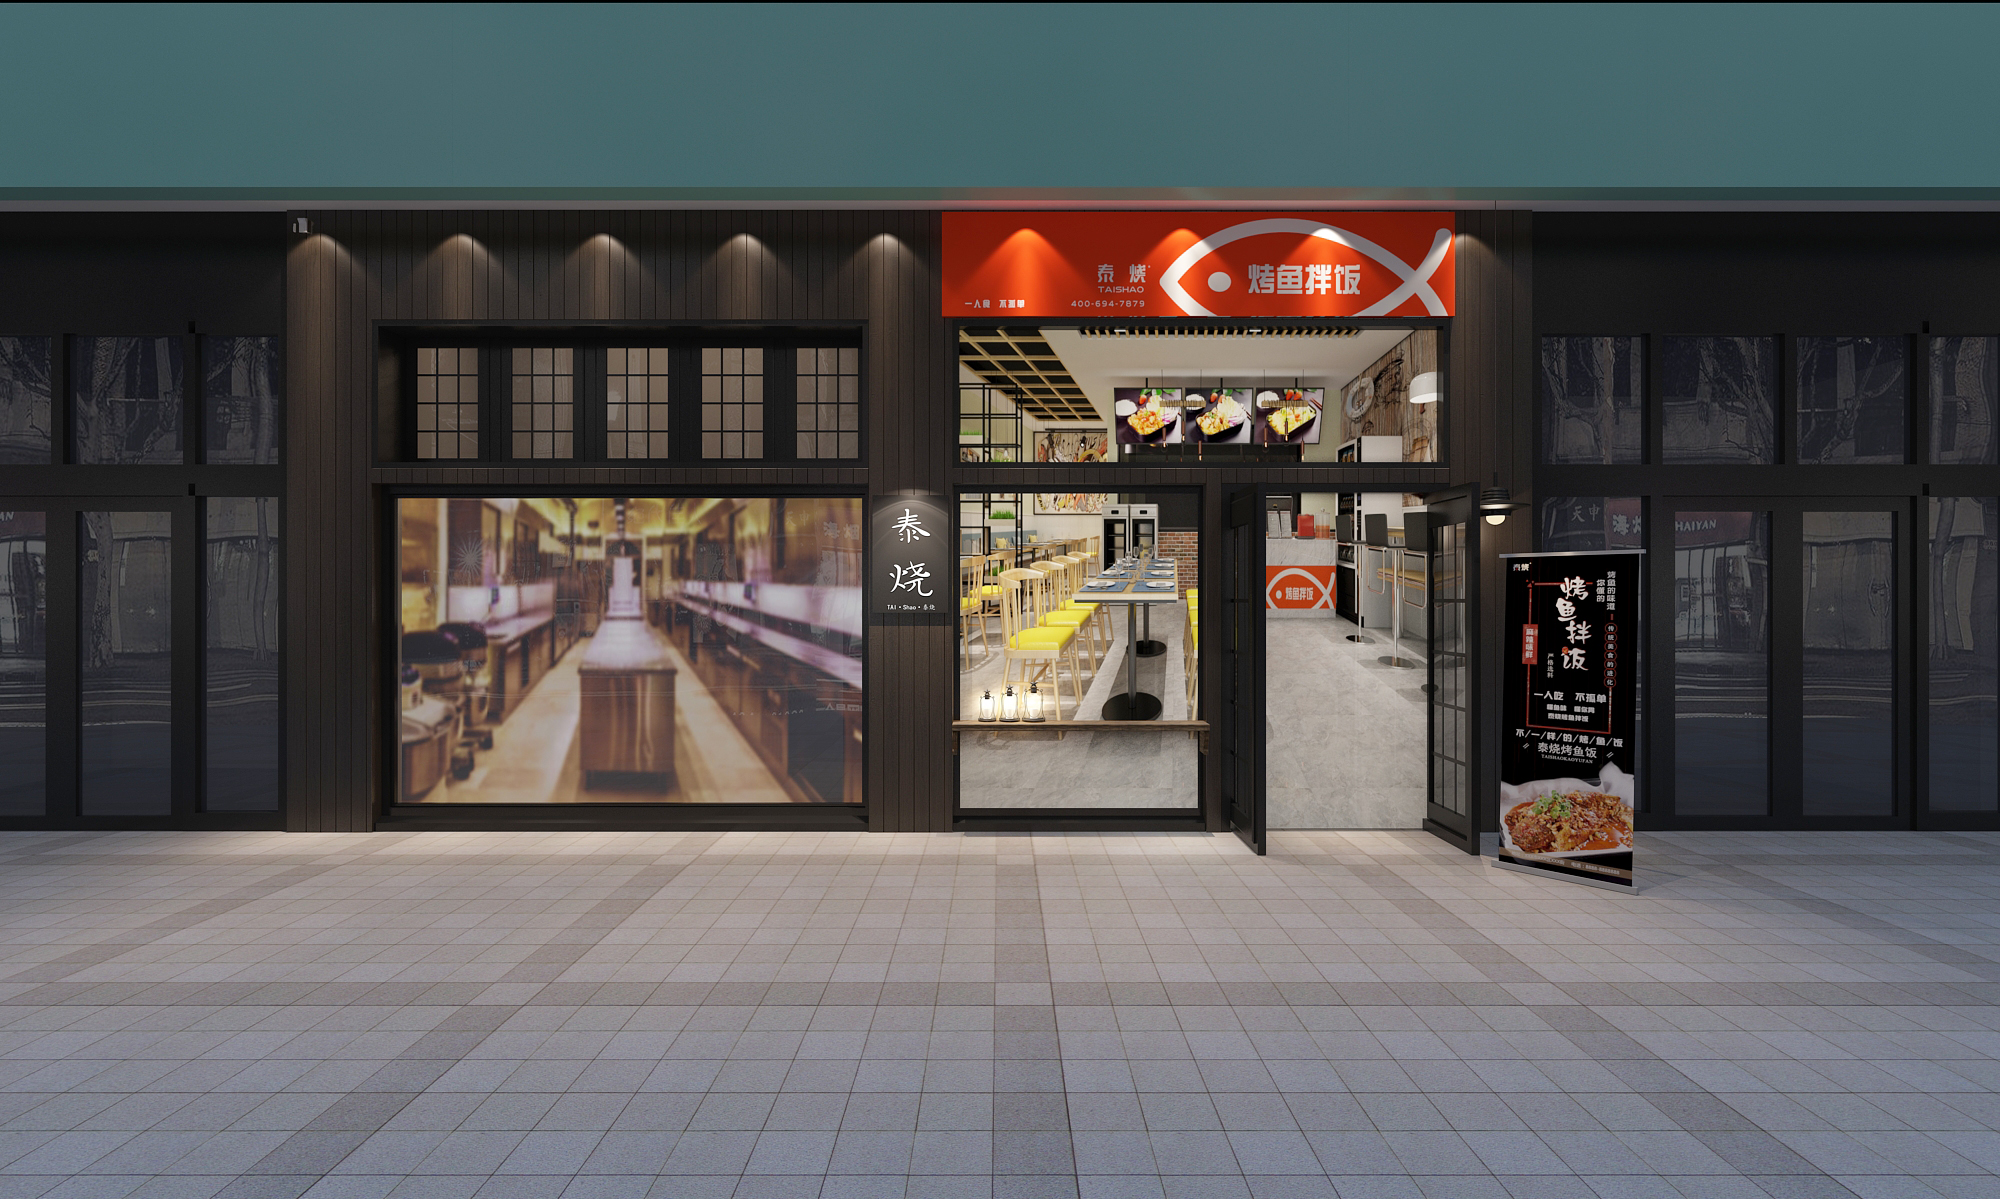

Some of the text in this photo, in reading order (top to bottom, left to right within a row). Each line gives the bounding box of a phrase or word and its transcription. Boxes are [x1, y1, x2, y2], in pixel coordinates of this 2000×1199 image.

[1248, 264, 1360, 295] 烤鱼拌饭
[1098, 286, 1144, 294] TAISHAO
[1675, 518, 1716, 532] HAIYAN
[889, 508, 934, 596] 泰烧
[1285, 587, 1314, 600] 烤鱼拌饭
[1596, 579, 1606, 602] 你懂的
[1607, 571, 1616, 611] 烤鱼的味道
[1555, 576, 1592, 671] 烤鱼拌饭
[1534, 691, 1607, 704] 一人吃 不孤单
[1537, 742, 1598, 759] 泰烧烤鱼饭
